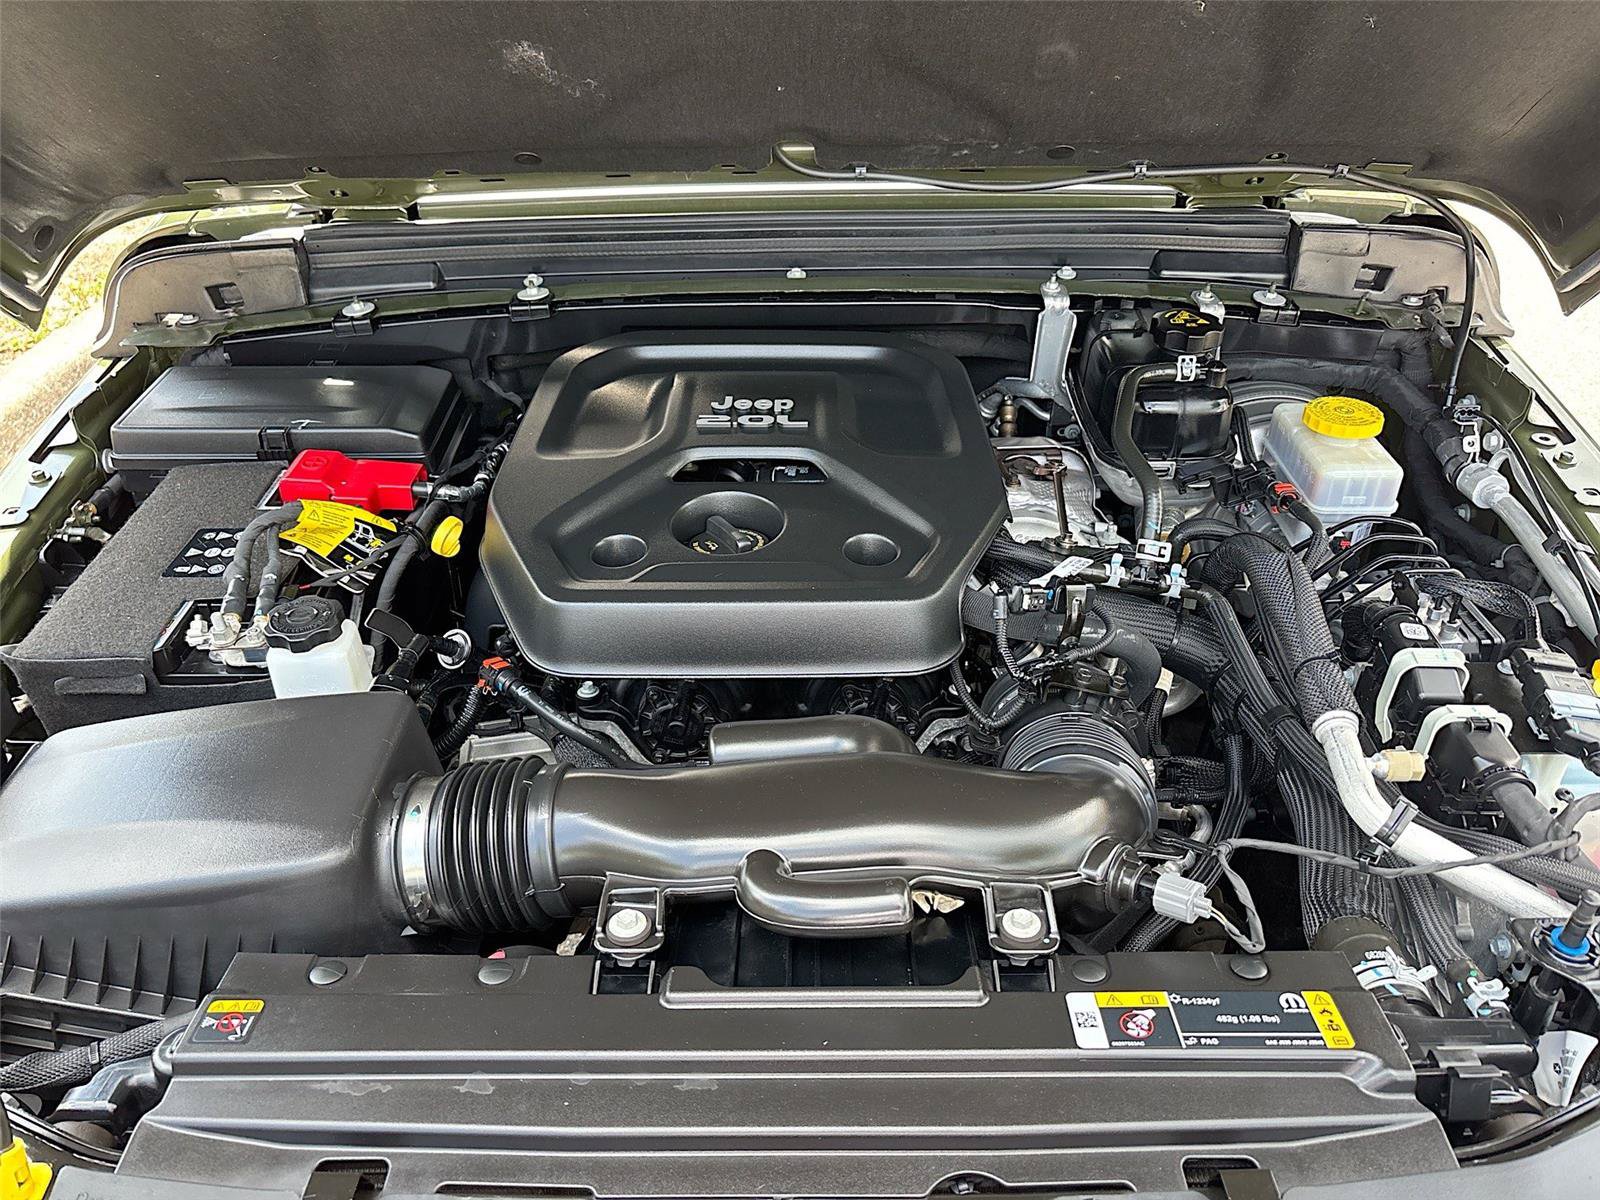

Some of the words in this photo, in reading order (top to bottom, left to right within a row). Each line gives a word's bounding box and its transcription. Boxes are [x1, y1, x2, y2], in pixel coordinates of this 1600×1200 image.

[710, 395, 795, 415] Jeep
[695, 414, 809, 428] 2.0L
[1261, 1014, 1281, 1024] lbs)
